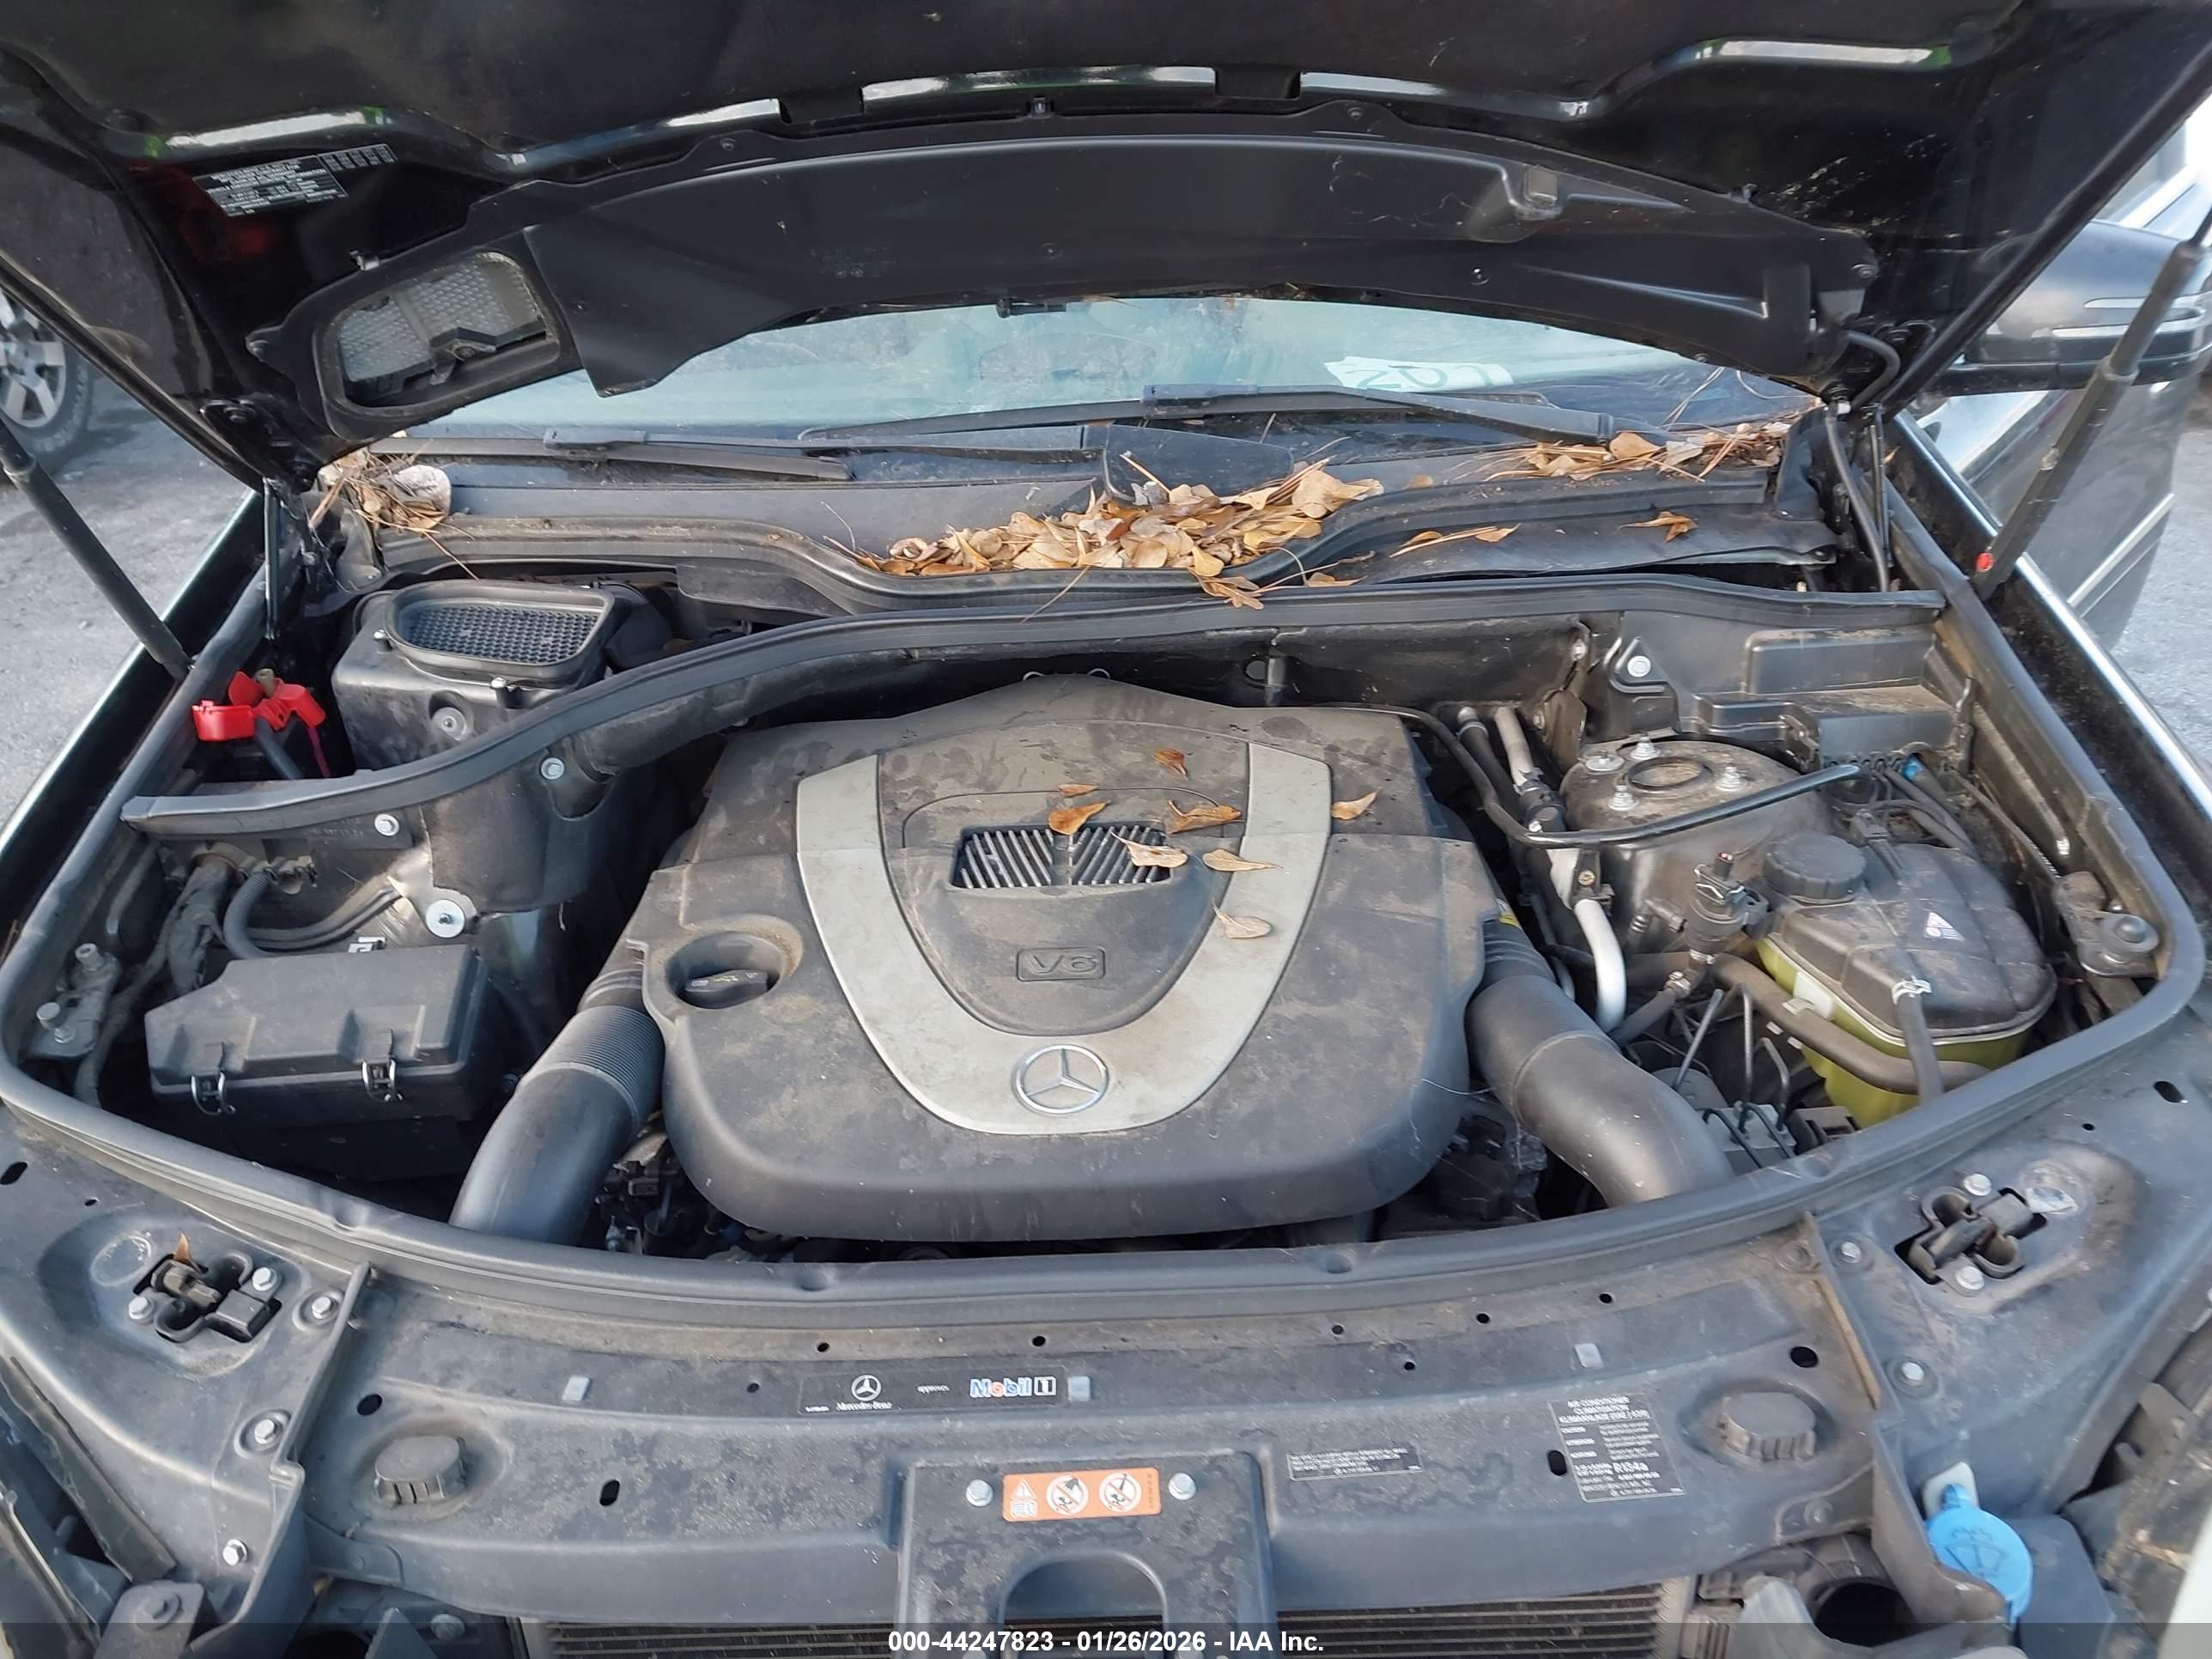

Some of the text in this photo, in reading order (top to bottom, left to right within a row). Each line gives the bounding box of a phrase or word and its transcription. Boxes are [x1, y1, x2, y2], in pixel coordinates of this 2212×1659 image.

[1025, 954, 1098, 975] V6
[969, 1377, 1032, 1397] Mobil
[1612, 1462, 1649, 1474] R134a
